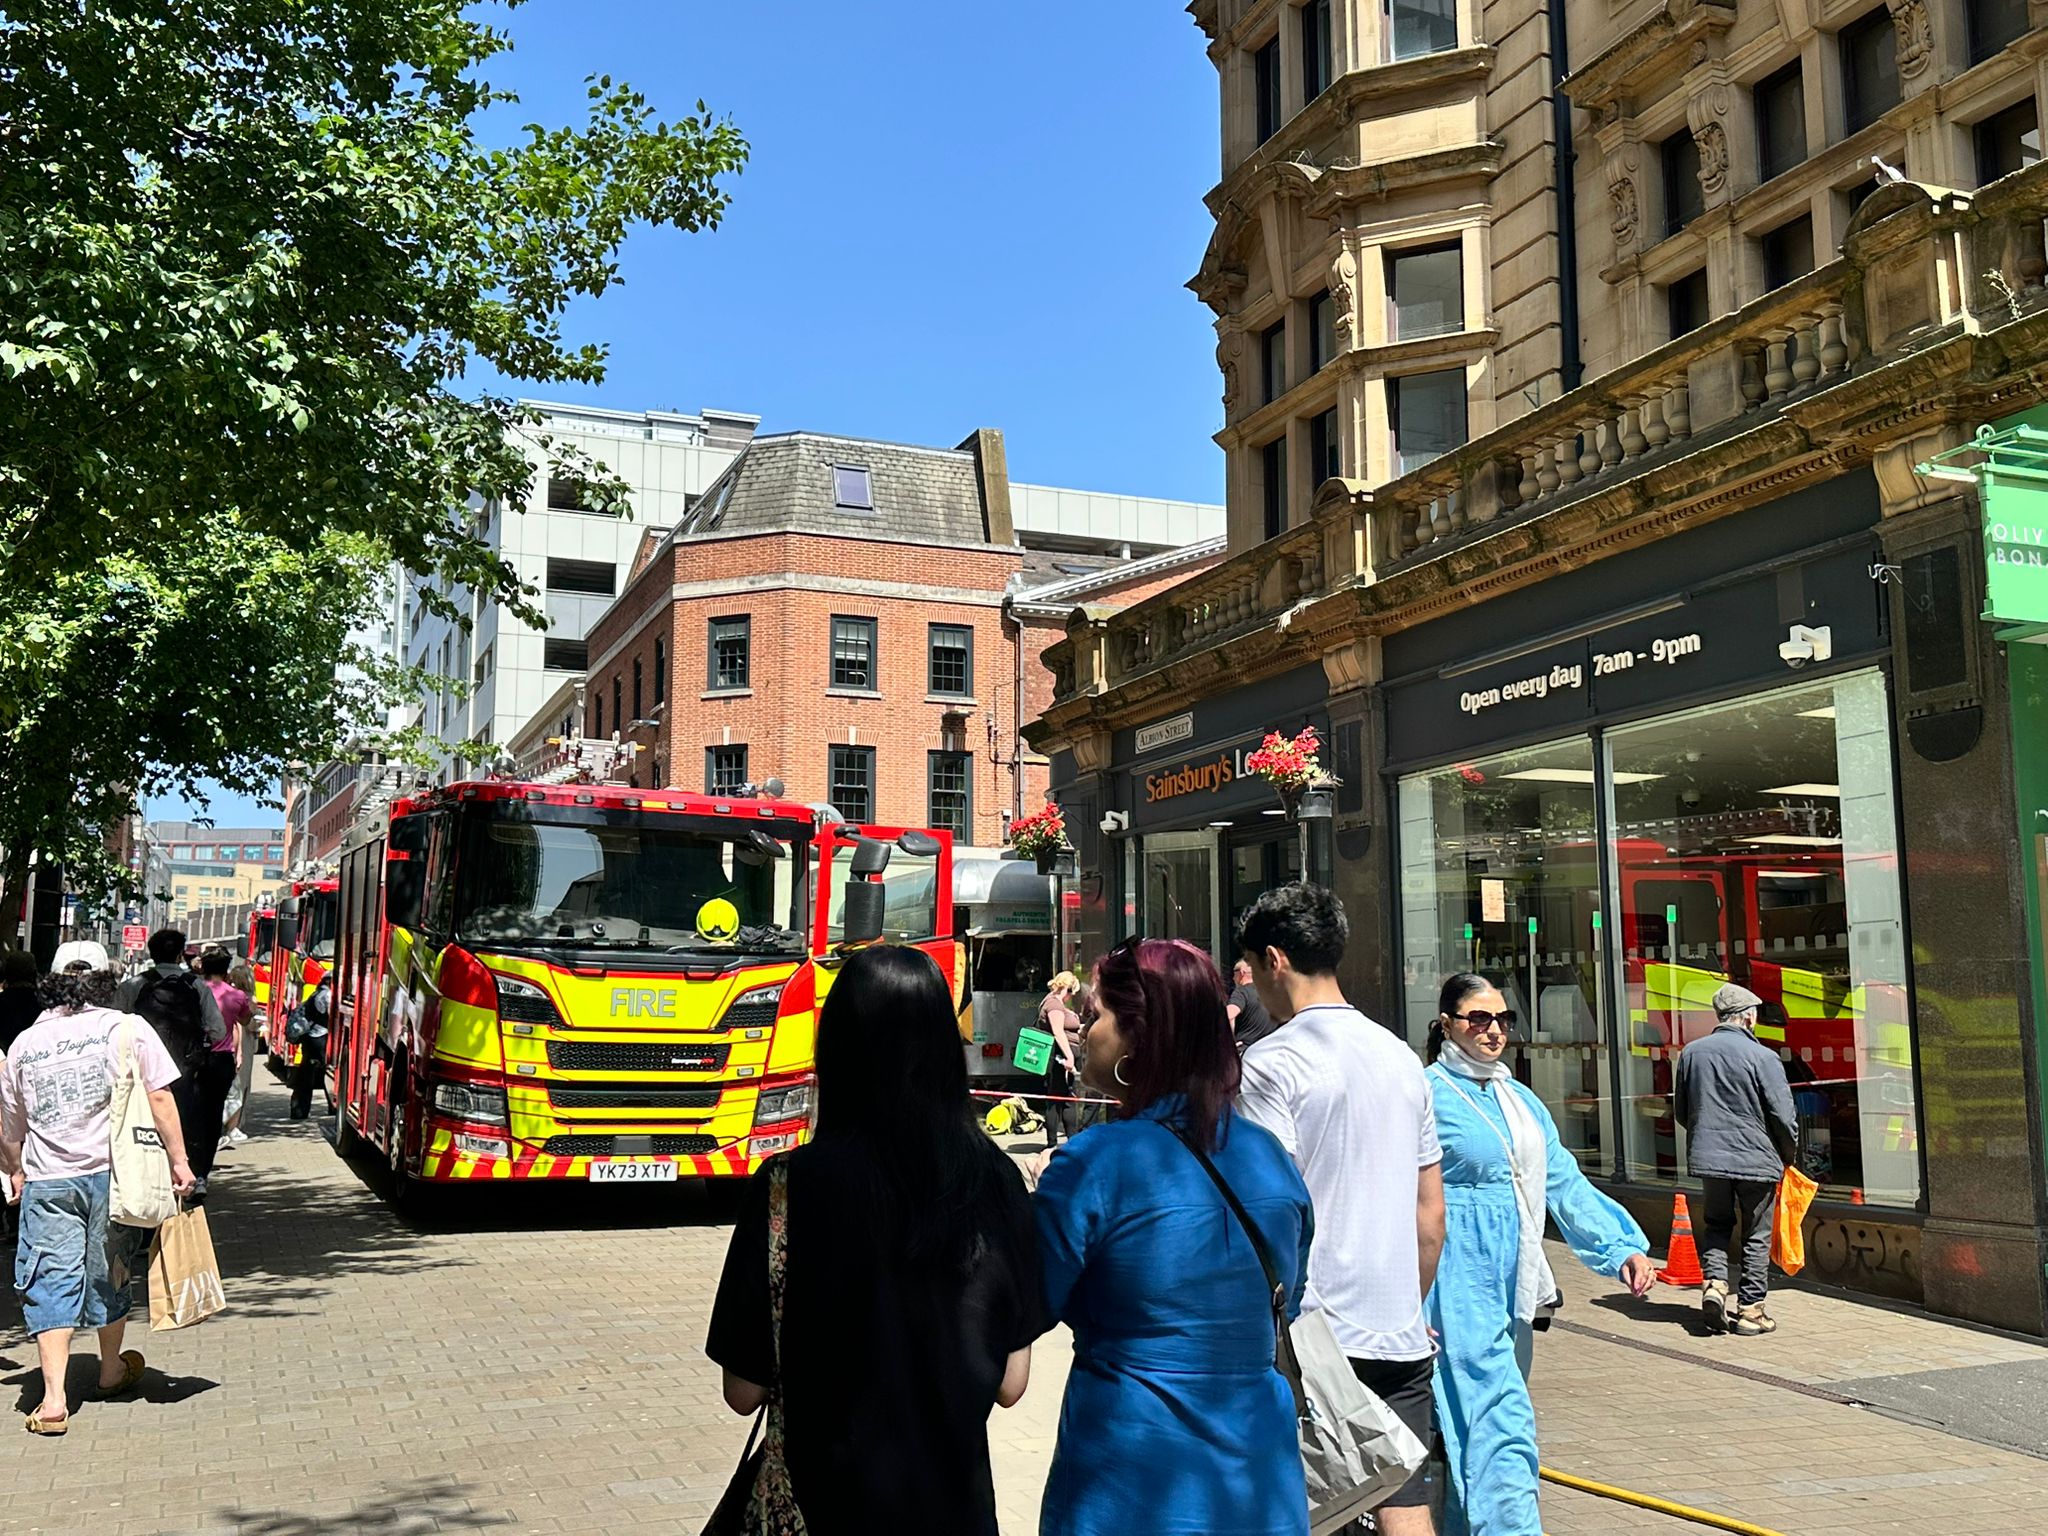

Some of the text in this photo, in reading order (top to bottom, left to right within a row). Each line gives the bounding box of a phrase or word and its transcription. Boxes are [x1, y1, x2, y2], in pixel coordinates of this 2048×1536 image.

[1996, 547, 2048, 568] BON
[1460, 686, 1500, 715] Open
[1502, 674, 1547, 701] every
[1549, 664, 1583, 688] day
[1593, 650, 1633, 676] 7am
[1652, 633, 1701, 664] 9pm
[1140, 721, 1190, 747] ALBION STREET
[1145, 748, 1255, 803] Sainsbury's Lo
[610, 987, 677, 1018] FIRE
[56, 1034, 109, 1055] Toujour
[598, 1164, 671, 1179] YK73 XTY
